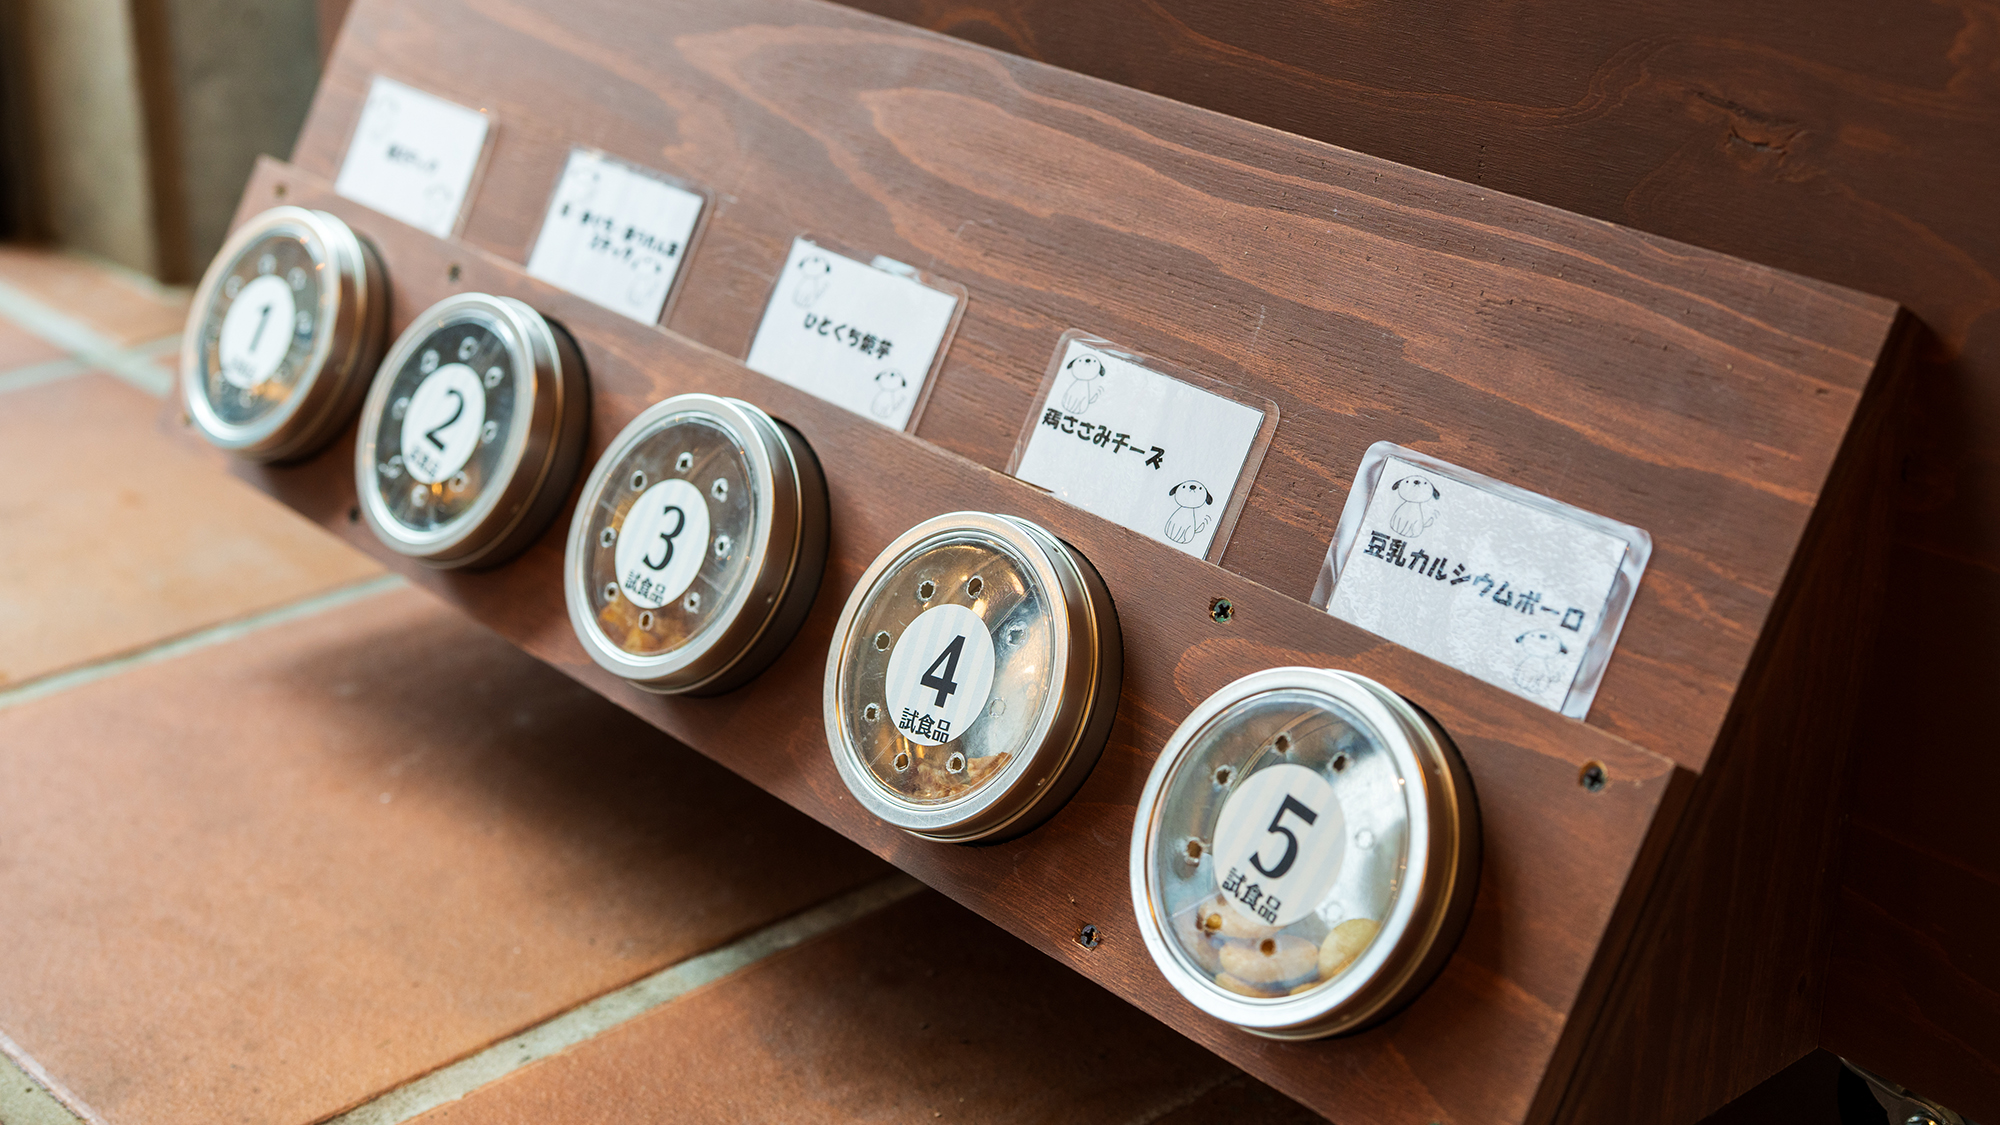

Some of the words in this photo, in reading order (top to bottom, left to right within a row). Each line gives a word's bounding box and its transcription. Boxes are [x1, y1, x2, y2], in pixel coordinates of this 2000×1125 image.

[248, 304, 272, 353] 1
[426, 389, 464, 450] 2
[642, 505, 685, 571] 3
[1363, 530, 1585, 632] 豆乳カルシウムボーロ
[920, 634, 966, 708] 4
[898, 707, 951, 743] 試食品
[1249, 794, 1318, 879] 5
[1222, 867, 1282, 924] 試食品
